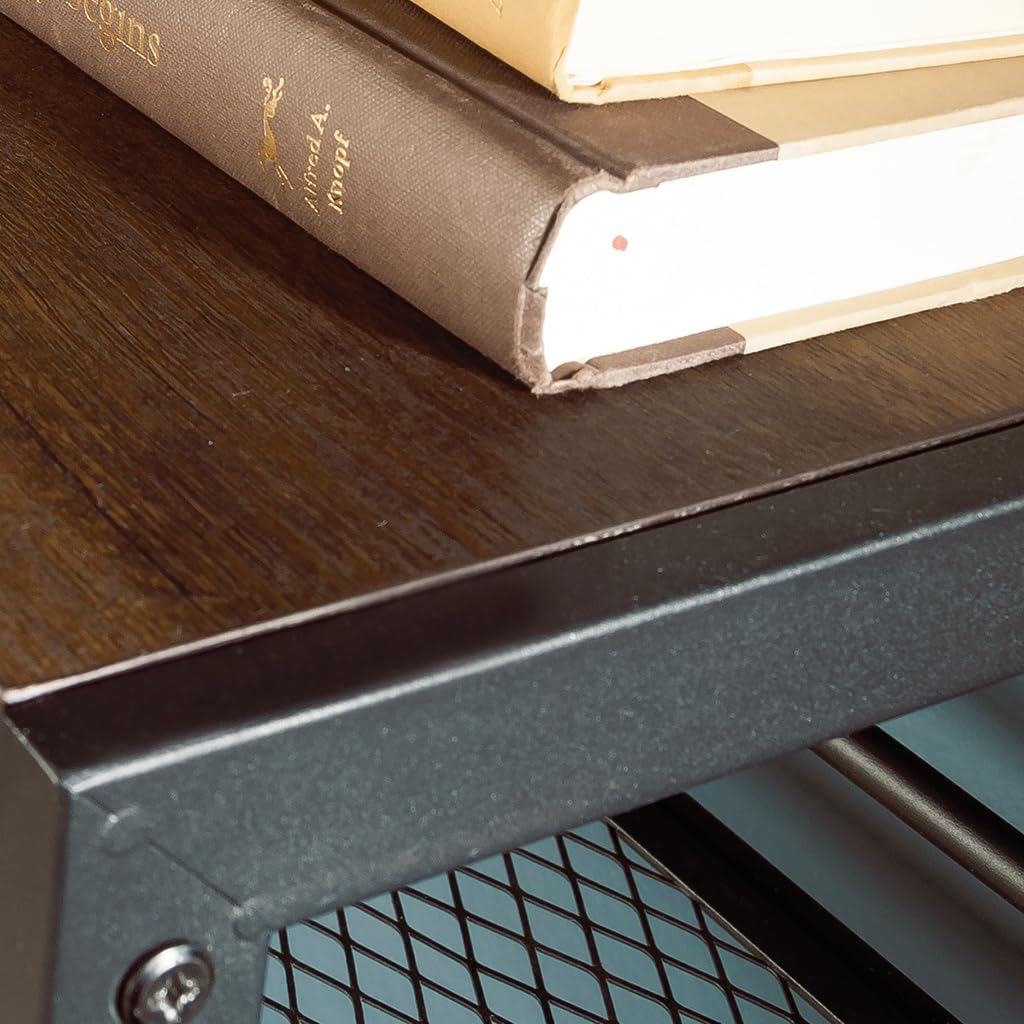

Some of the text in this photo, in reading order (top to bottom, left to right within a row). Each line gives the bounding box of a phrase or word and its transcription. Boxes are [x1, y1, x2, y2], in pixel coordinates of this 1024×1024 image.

[303, 103, 332, 217] Alfred A.
[327, 128, 353, 216] Knopf
